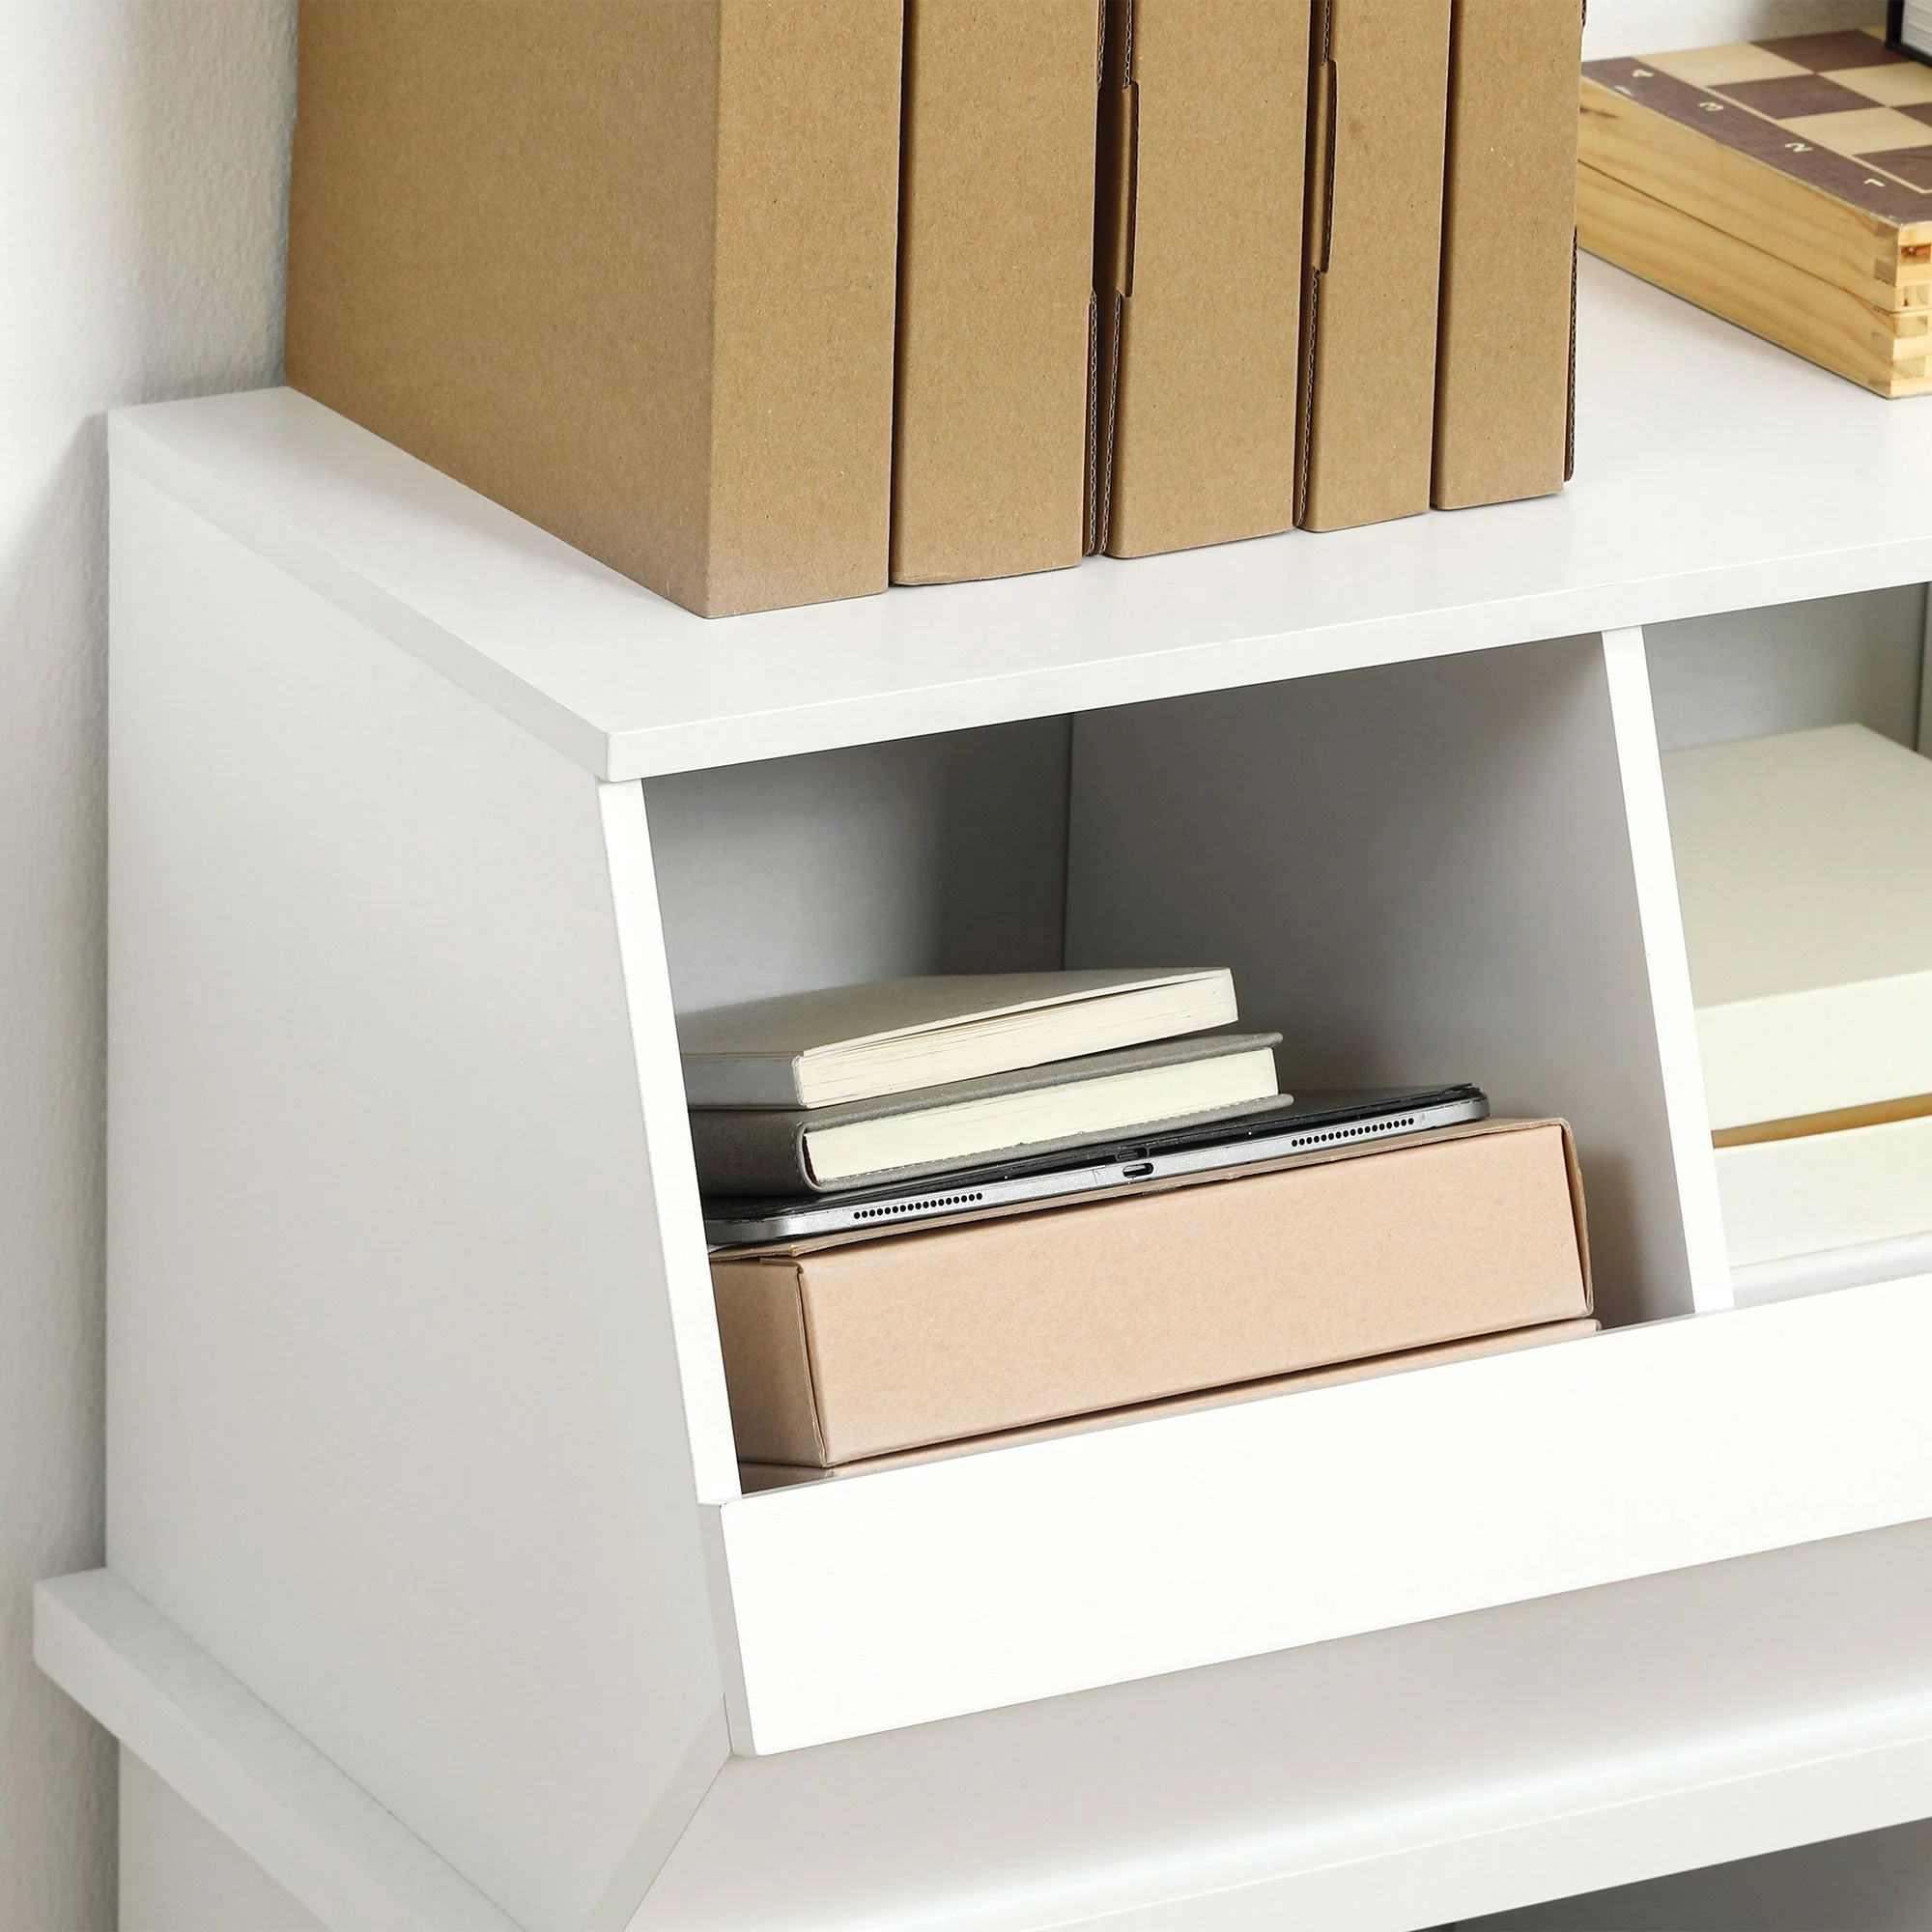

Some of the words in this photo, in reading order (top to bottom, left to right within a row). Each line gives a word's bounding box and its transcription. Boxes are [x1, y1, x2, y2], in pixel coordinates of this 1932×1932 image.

[1698, 101, 1724, 111] 3
[1784, 142, 1813, 153] 2
[1863, 178, 1885, 187] 1
